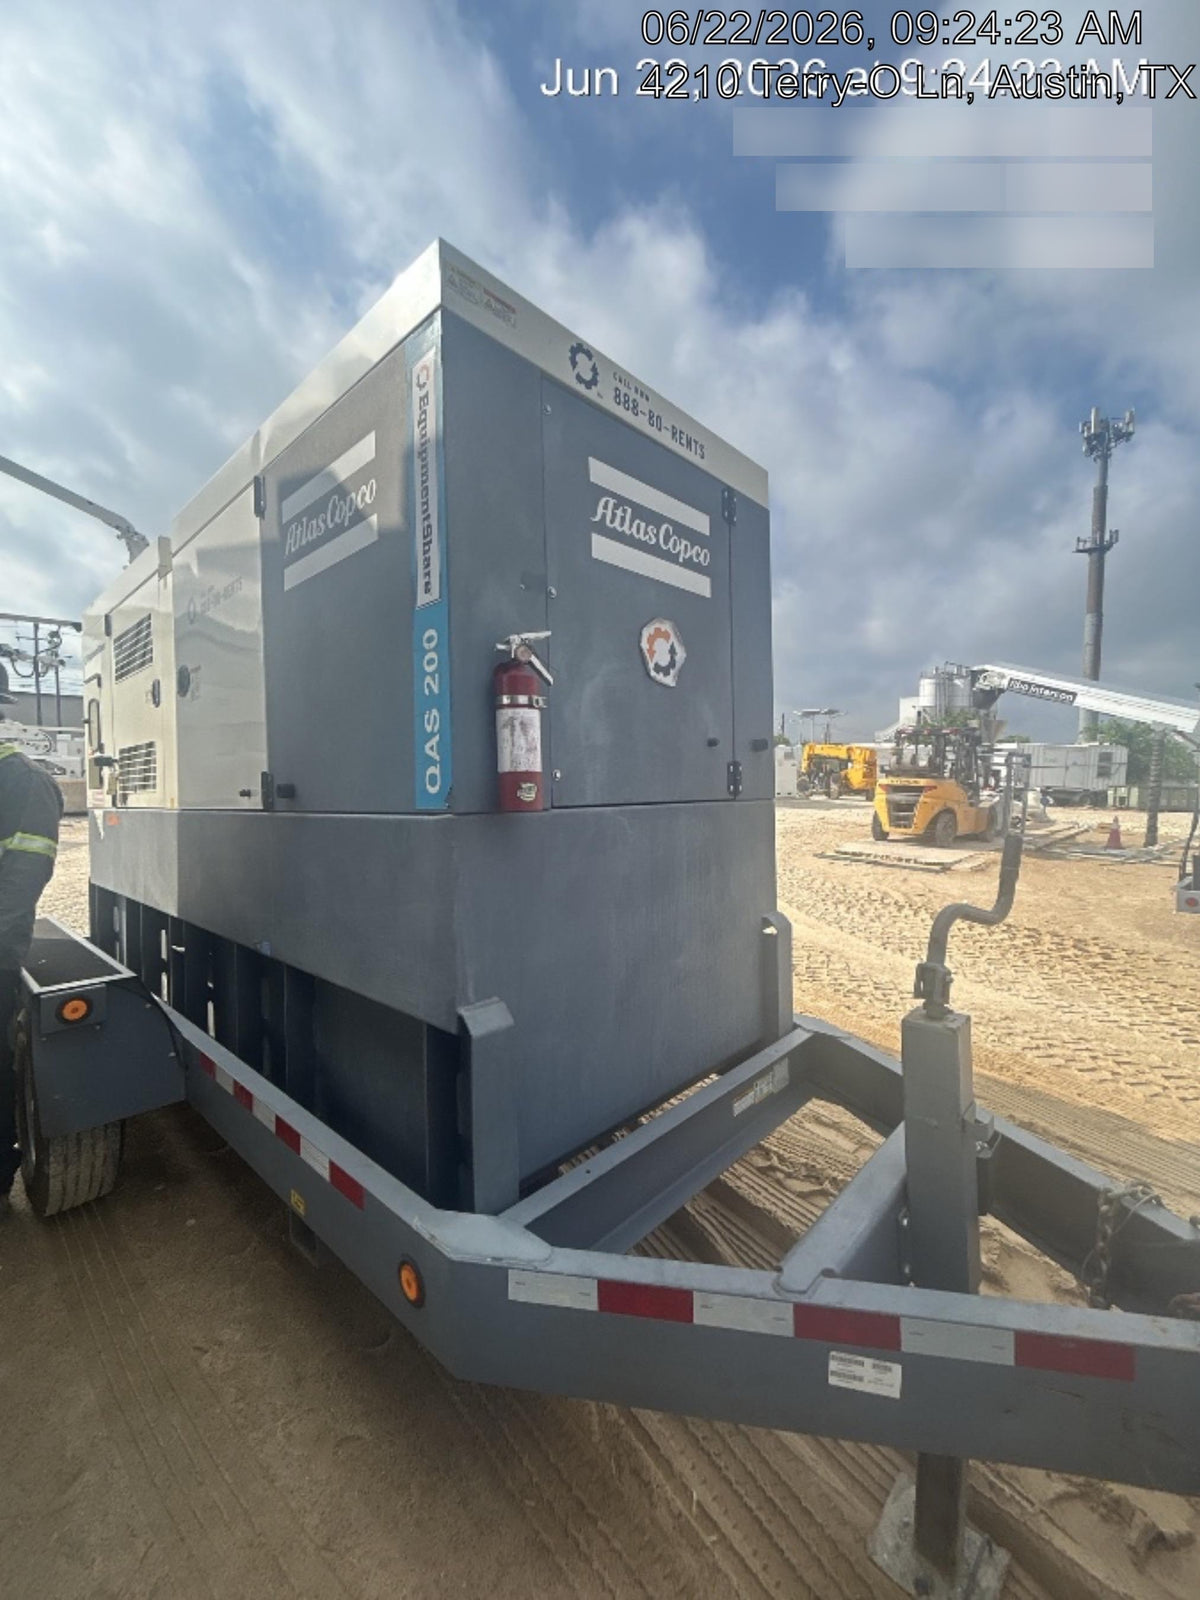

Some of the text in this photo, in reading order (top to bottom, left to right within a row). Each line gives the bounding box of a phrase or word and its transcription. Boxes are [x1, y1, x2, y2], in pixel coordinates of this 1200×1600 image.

[417, 393, 433, 596] EquipmentShare
[422, 628, 441, 794] QAS 200
